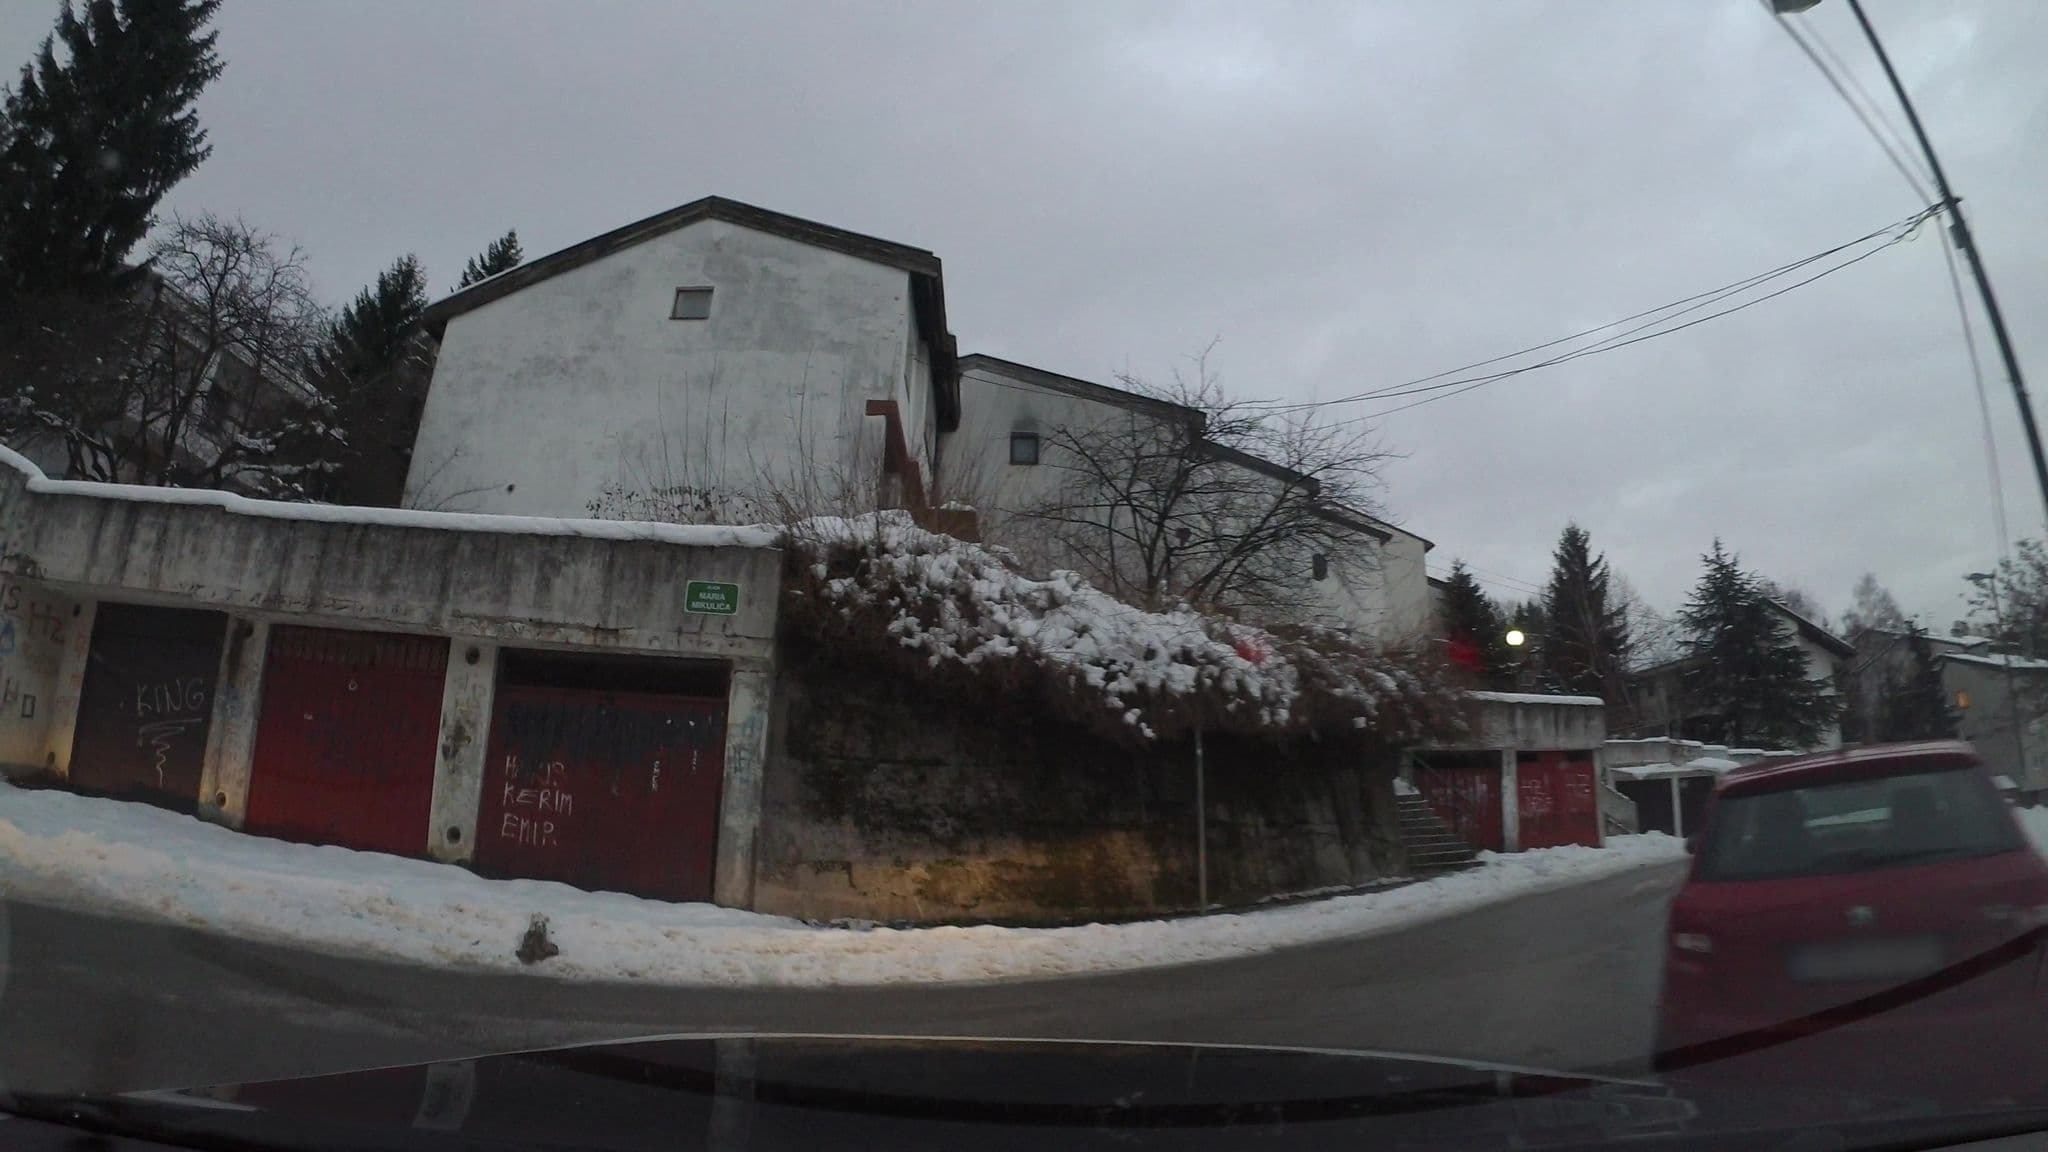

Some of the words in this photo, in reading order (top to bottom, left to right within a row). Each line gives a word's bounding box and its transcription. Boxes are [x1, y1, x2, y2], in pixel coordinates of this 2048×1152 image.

[699, 591, 726, 601] MARIA
[136, 678, 205, 715] KING
[503, 781, 573, 816] KERIM
[501, 812, 558, 847] EMIR
